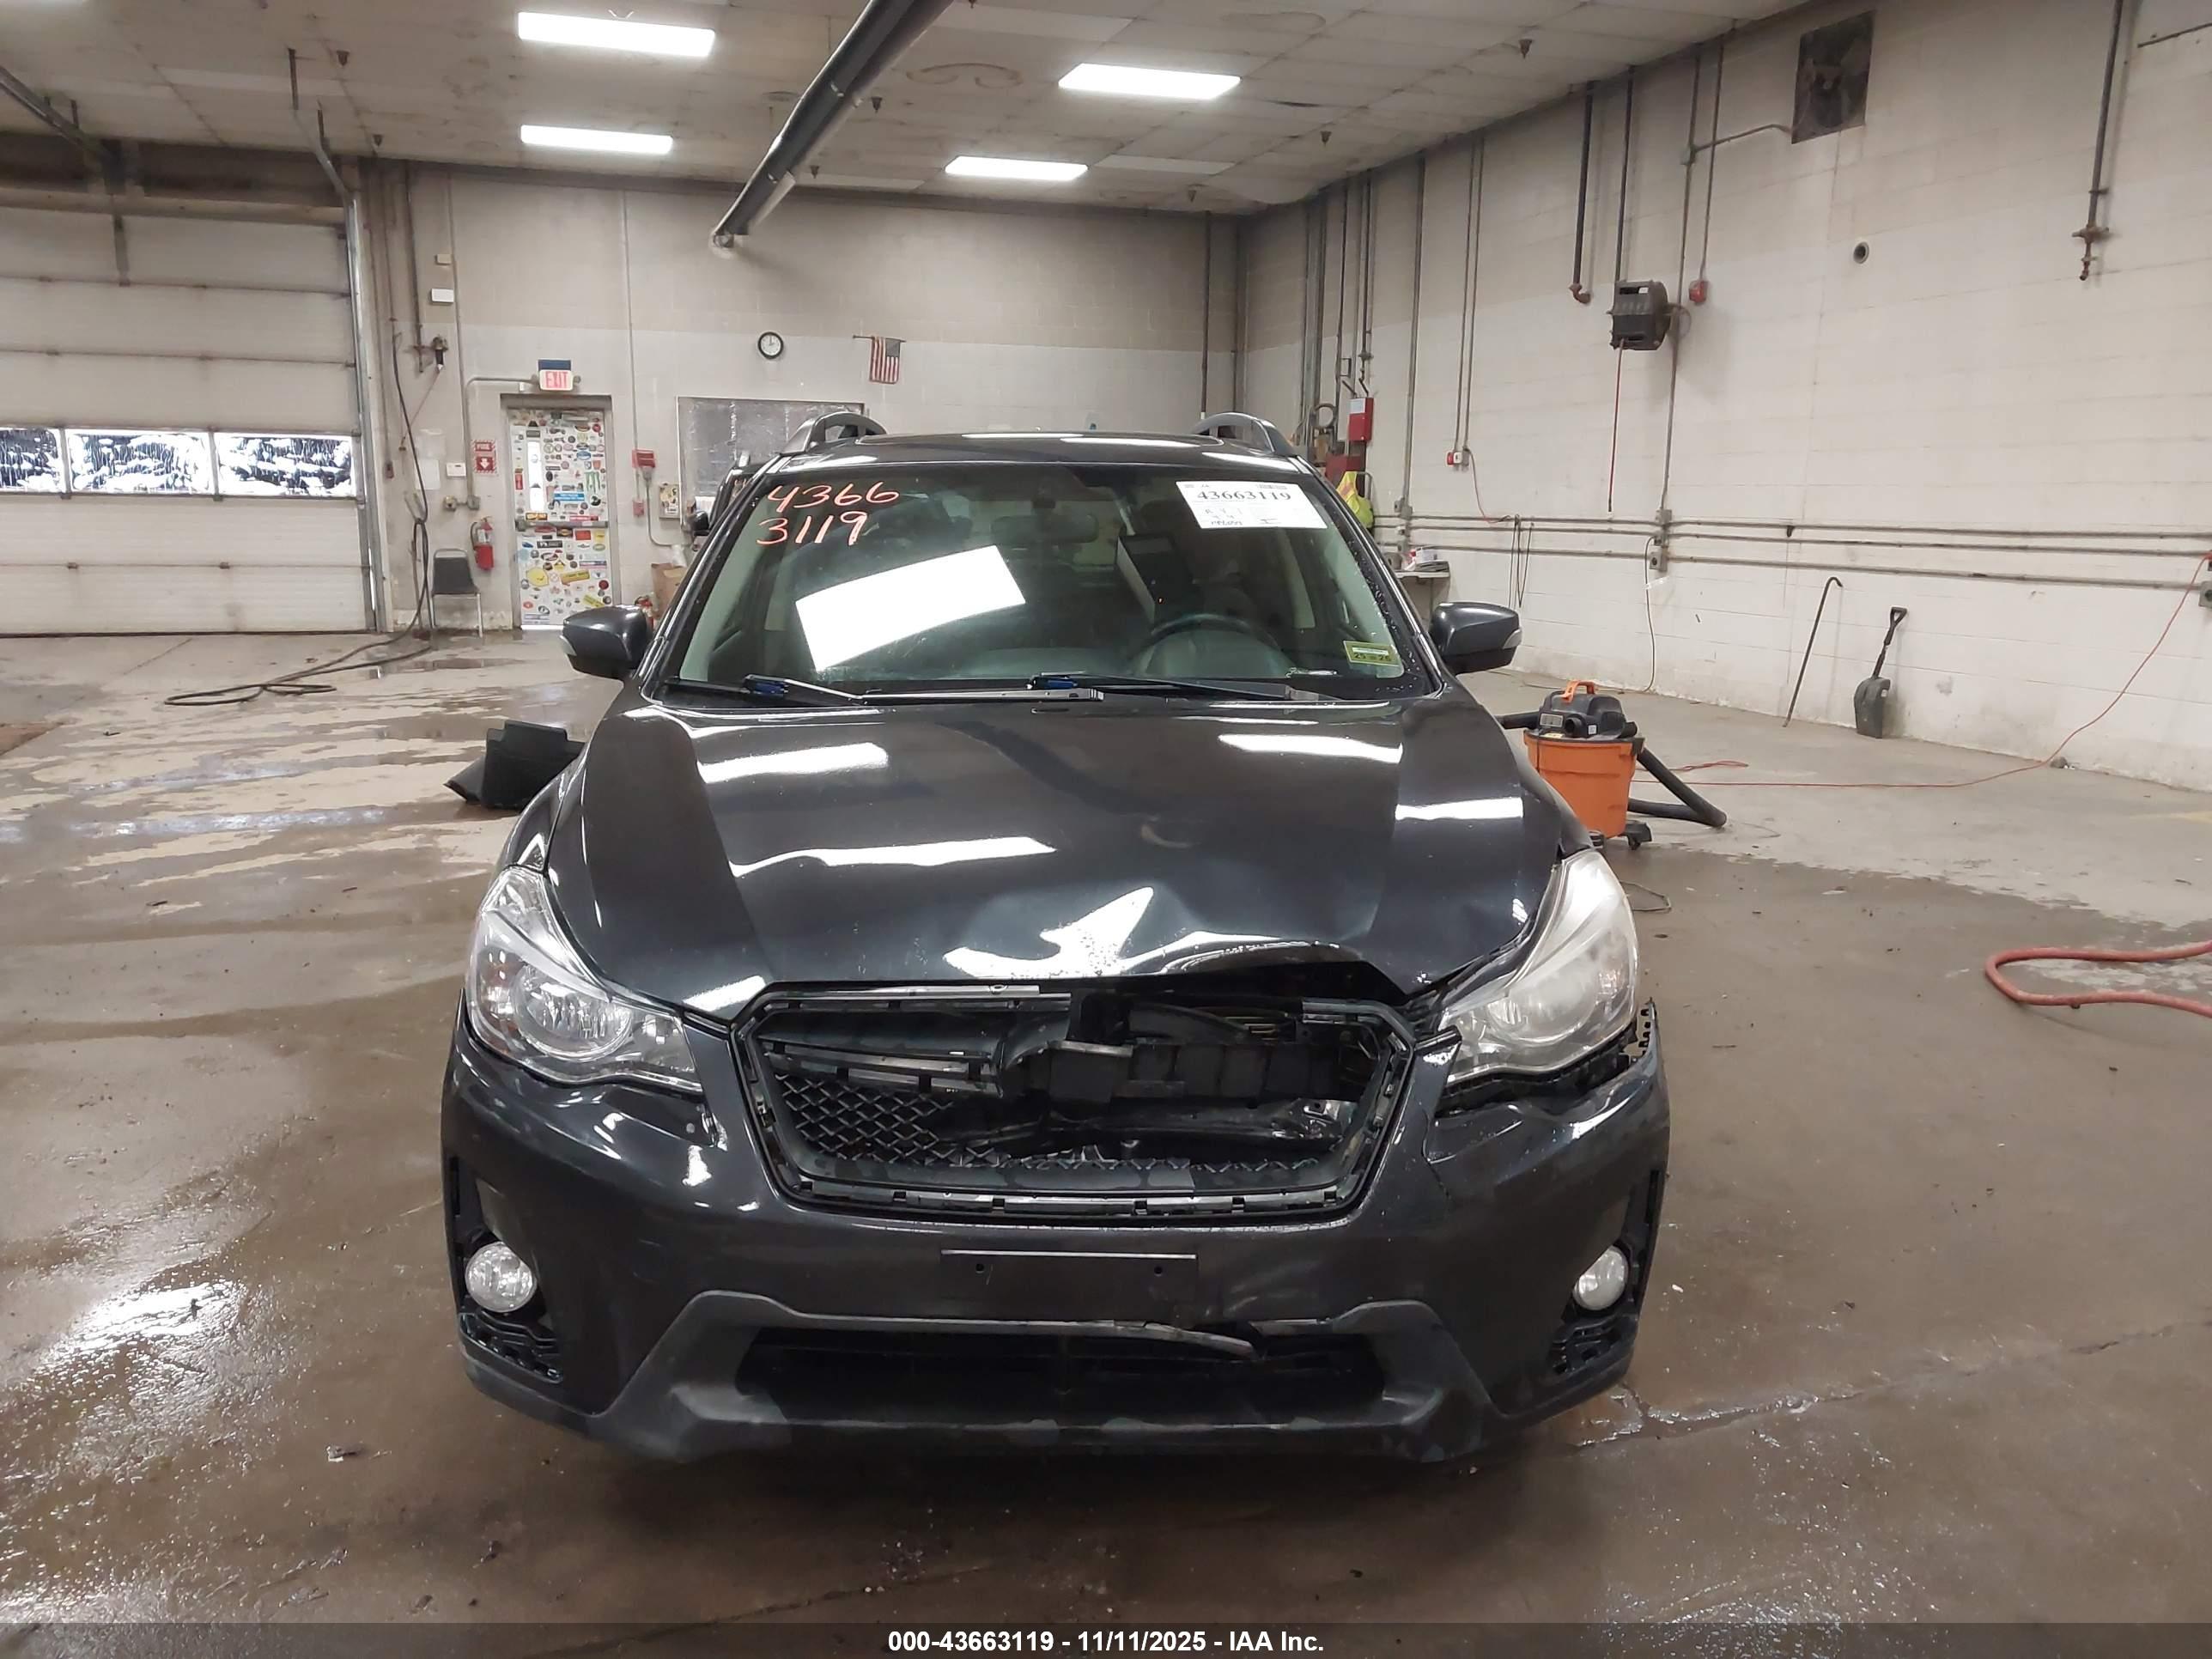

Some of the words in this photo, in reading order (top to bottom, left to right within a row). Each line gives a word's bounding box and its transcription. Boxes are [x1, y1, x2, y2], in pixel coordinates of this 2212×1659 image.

[545, 370, 568, 389] EXIT
[767, 481, 900, 514] 4366
[1196, 490, 1292, 501] 43663119
[756, 510, 869, 546] 3119
